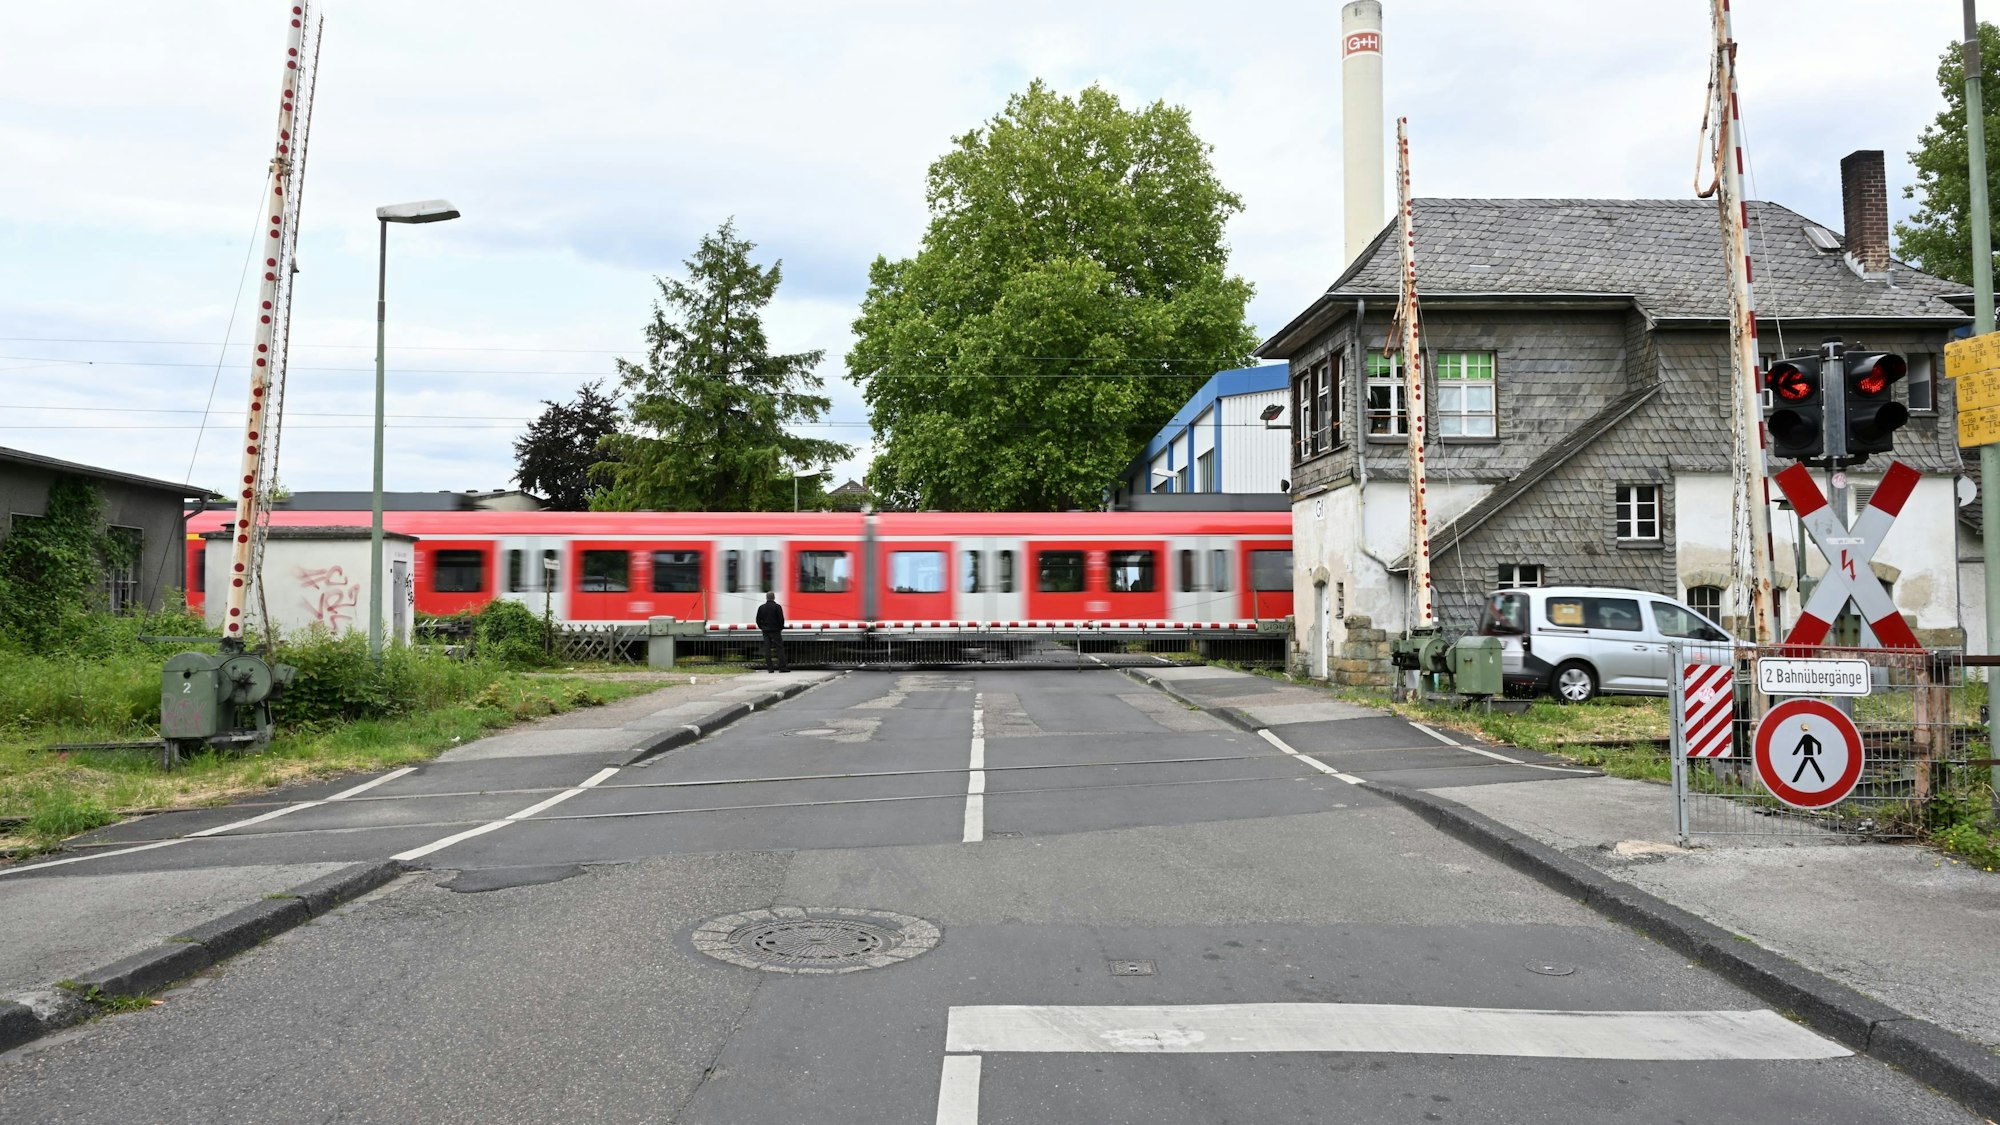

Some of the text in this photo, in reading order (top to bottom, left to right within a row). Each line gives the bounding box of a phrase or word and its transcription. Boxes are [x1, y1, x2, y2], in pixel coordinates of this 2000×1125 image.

[1348, 35, 1378, 50] G+H
[1765, 668, 1862, 687] 2 Bahnübergänge
[183, 682, 192, 694] 2
